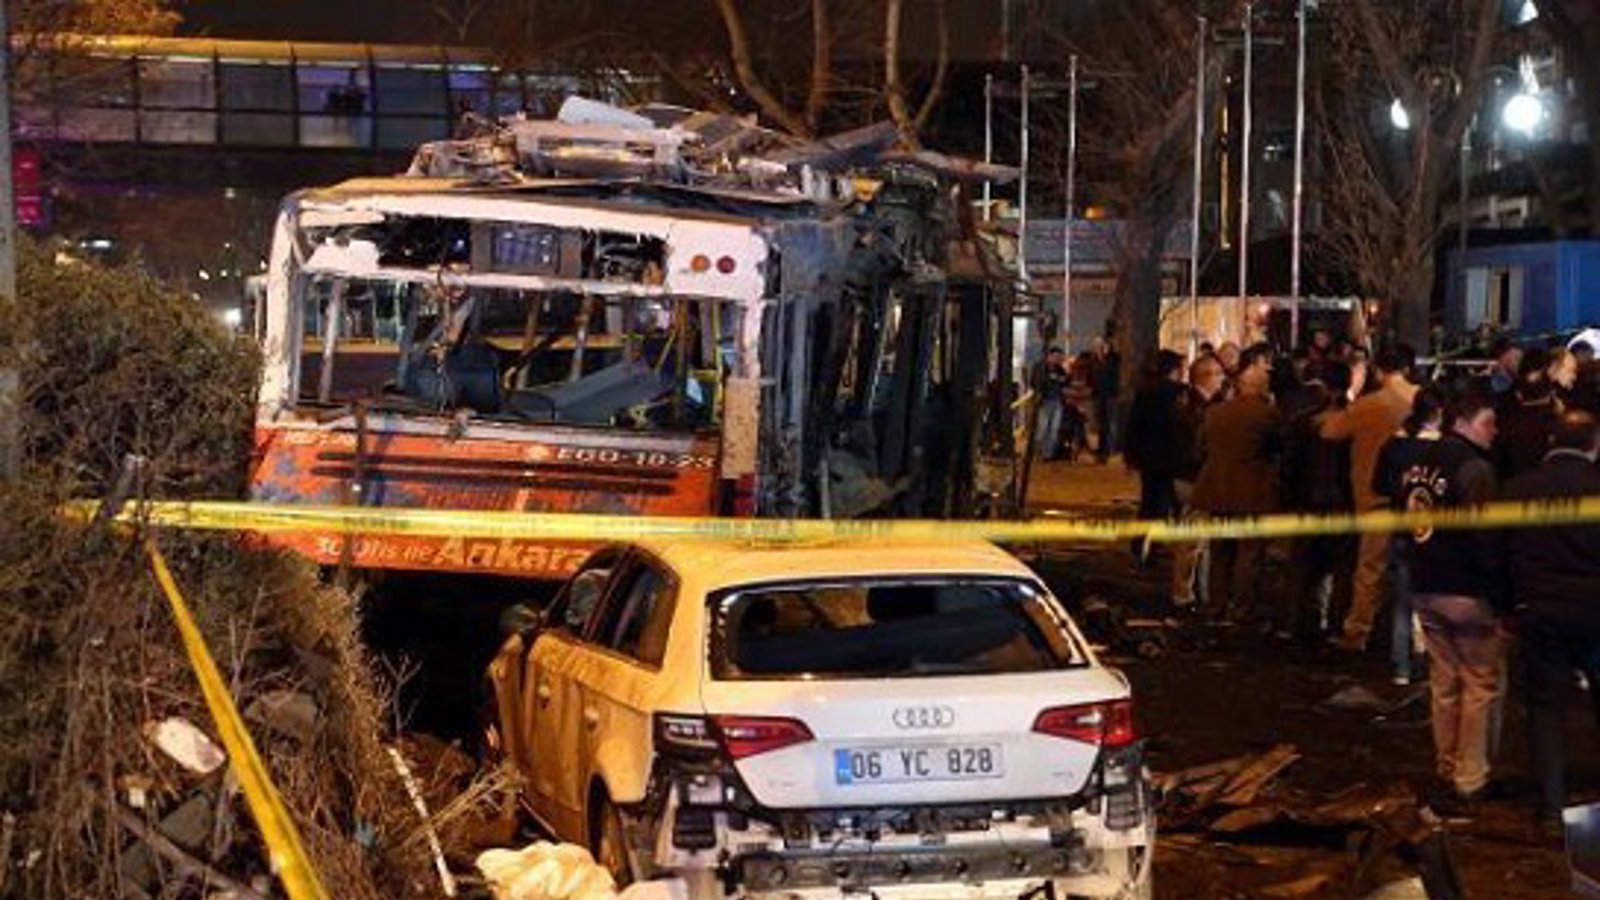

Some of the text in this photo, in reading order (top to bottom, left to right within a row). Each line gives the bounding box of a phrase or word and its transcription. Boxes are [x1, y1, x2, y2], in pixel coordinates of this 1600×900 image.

[851, 748, 993, 779] 06 YC 828
